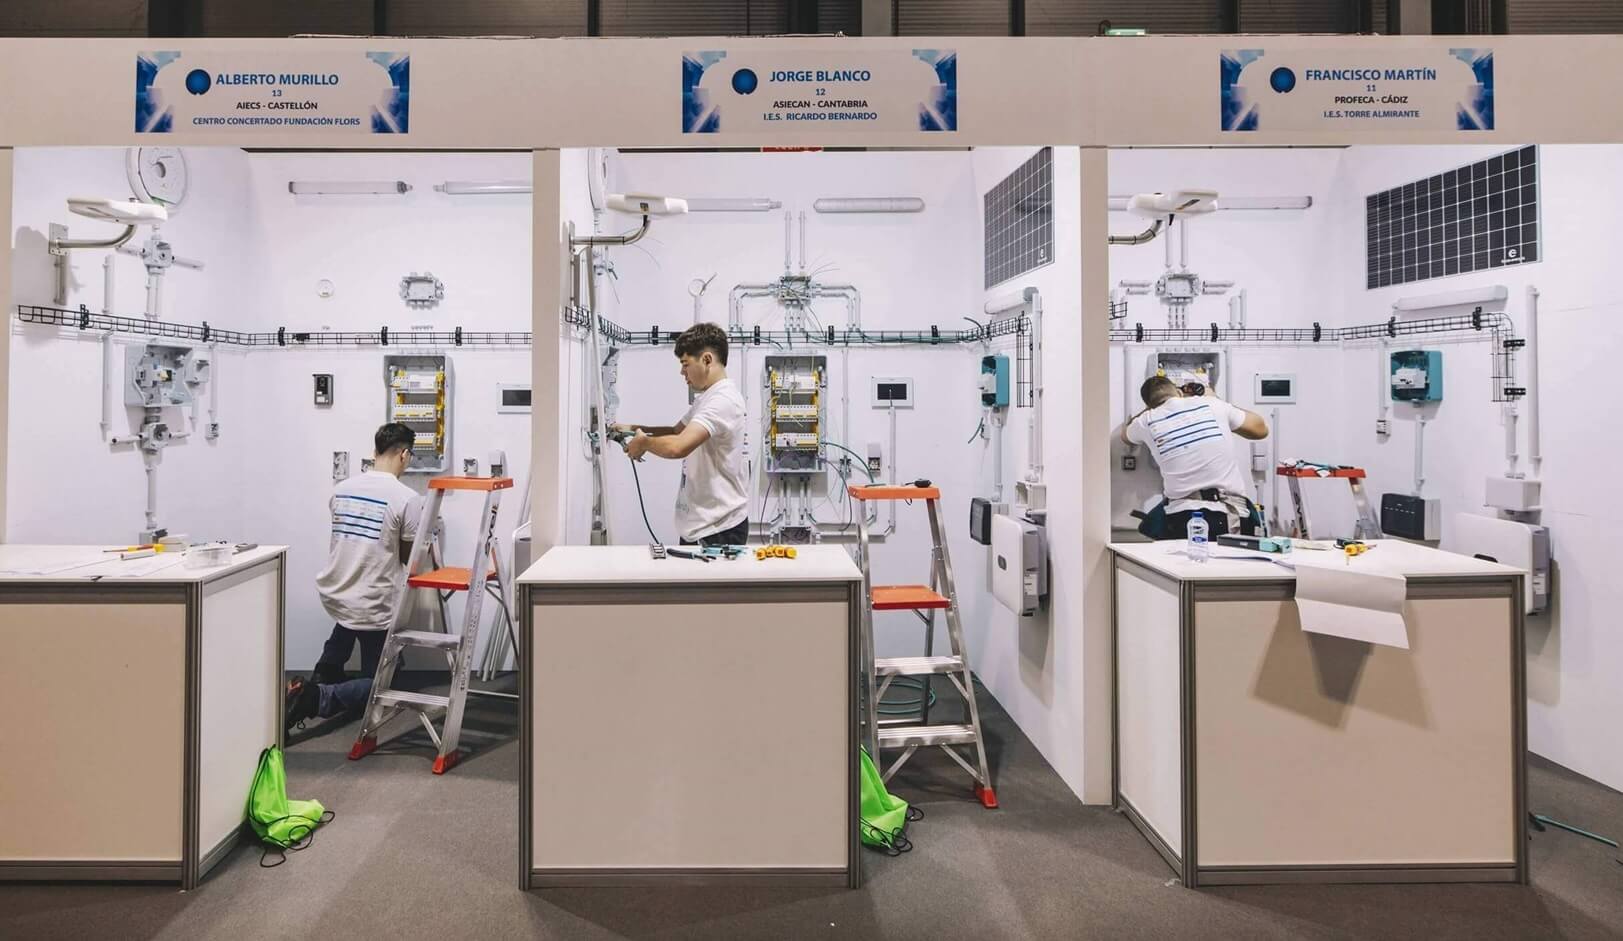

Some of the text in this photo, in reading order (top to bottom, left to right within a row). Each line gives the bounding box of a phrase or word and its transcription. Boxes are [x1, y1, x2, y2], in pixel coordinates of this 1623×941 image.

[770, 70, 871, 82] JORGE BLANCO
[1306, 67, 1436, 80] FRANCISCO MARTÍN
[216, 74, 339, 85] ALBERTO MURILLO
[816, 88, 826, 97] 12
[1366, 84, 1376, 93] 11
[272, 89, 282, 98] 13
[1334, 95, 1375, 104] PROFECA
[1381, 94, 1408, 104] CÁDIZ
[236, 101, 261, 110] AIECS
[267, 100, 318, 110] CASTELLÓN
[773, 100, 811, 109] ASIECAN
[817, 100, 868, 109] CANTABRIA
[763, 112, 878, 121] I.E.S. RICARDO BERNARDO
[1323, 110, 1419, 119] I.E.S. TORRE ALMIRANTE
[192, 115, 361, 126] CENTRO CONCERTADO FUNDACIÓN FLORS
